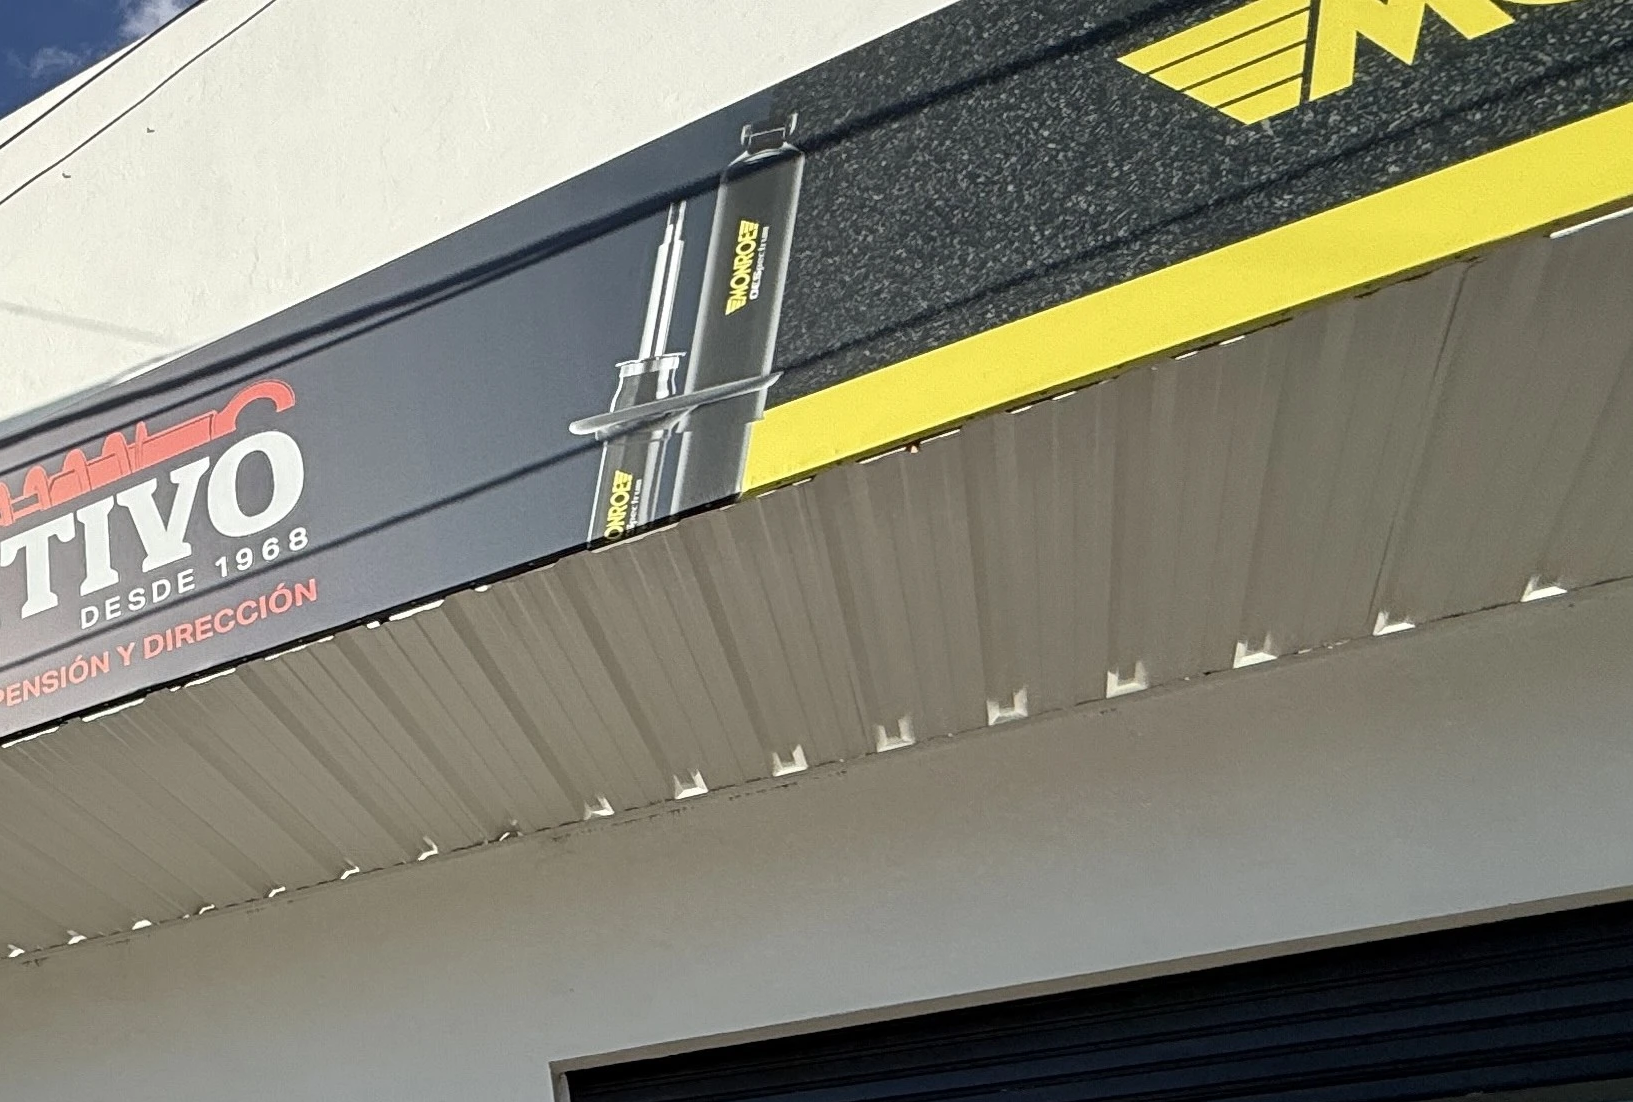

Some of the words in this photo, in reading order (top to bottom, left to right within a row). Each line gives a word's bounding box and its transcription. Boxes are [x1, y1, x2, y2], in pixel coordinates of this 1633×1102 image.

[725, 220, 759, 315] MONROE
[603, 470, 633, 539] ONROE
[80, 567, 196, 629] DESDE
[214, 526, 310, 579] 1968
[115, 643, 136, 667] Y
[142, 577, 319, 661] DIRECCIÓN
